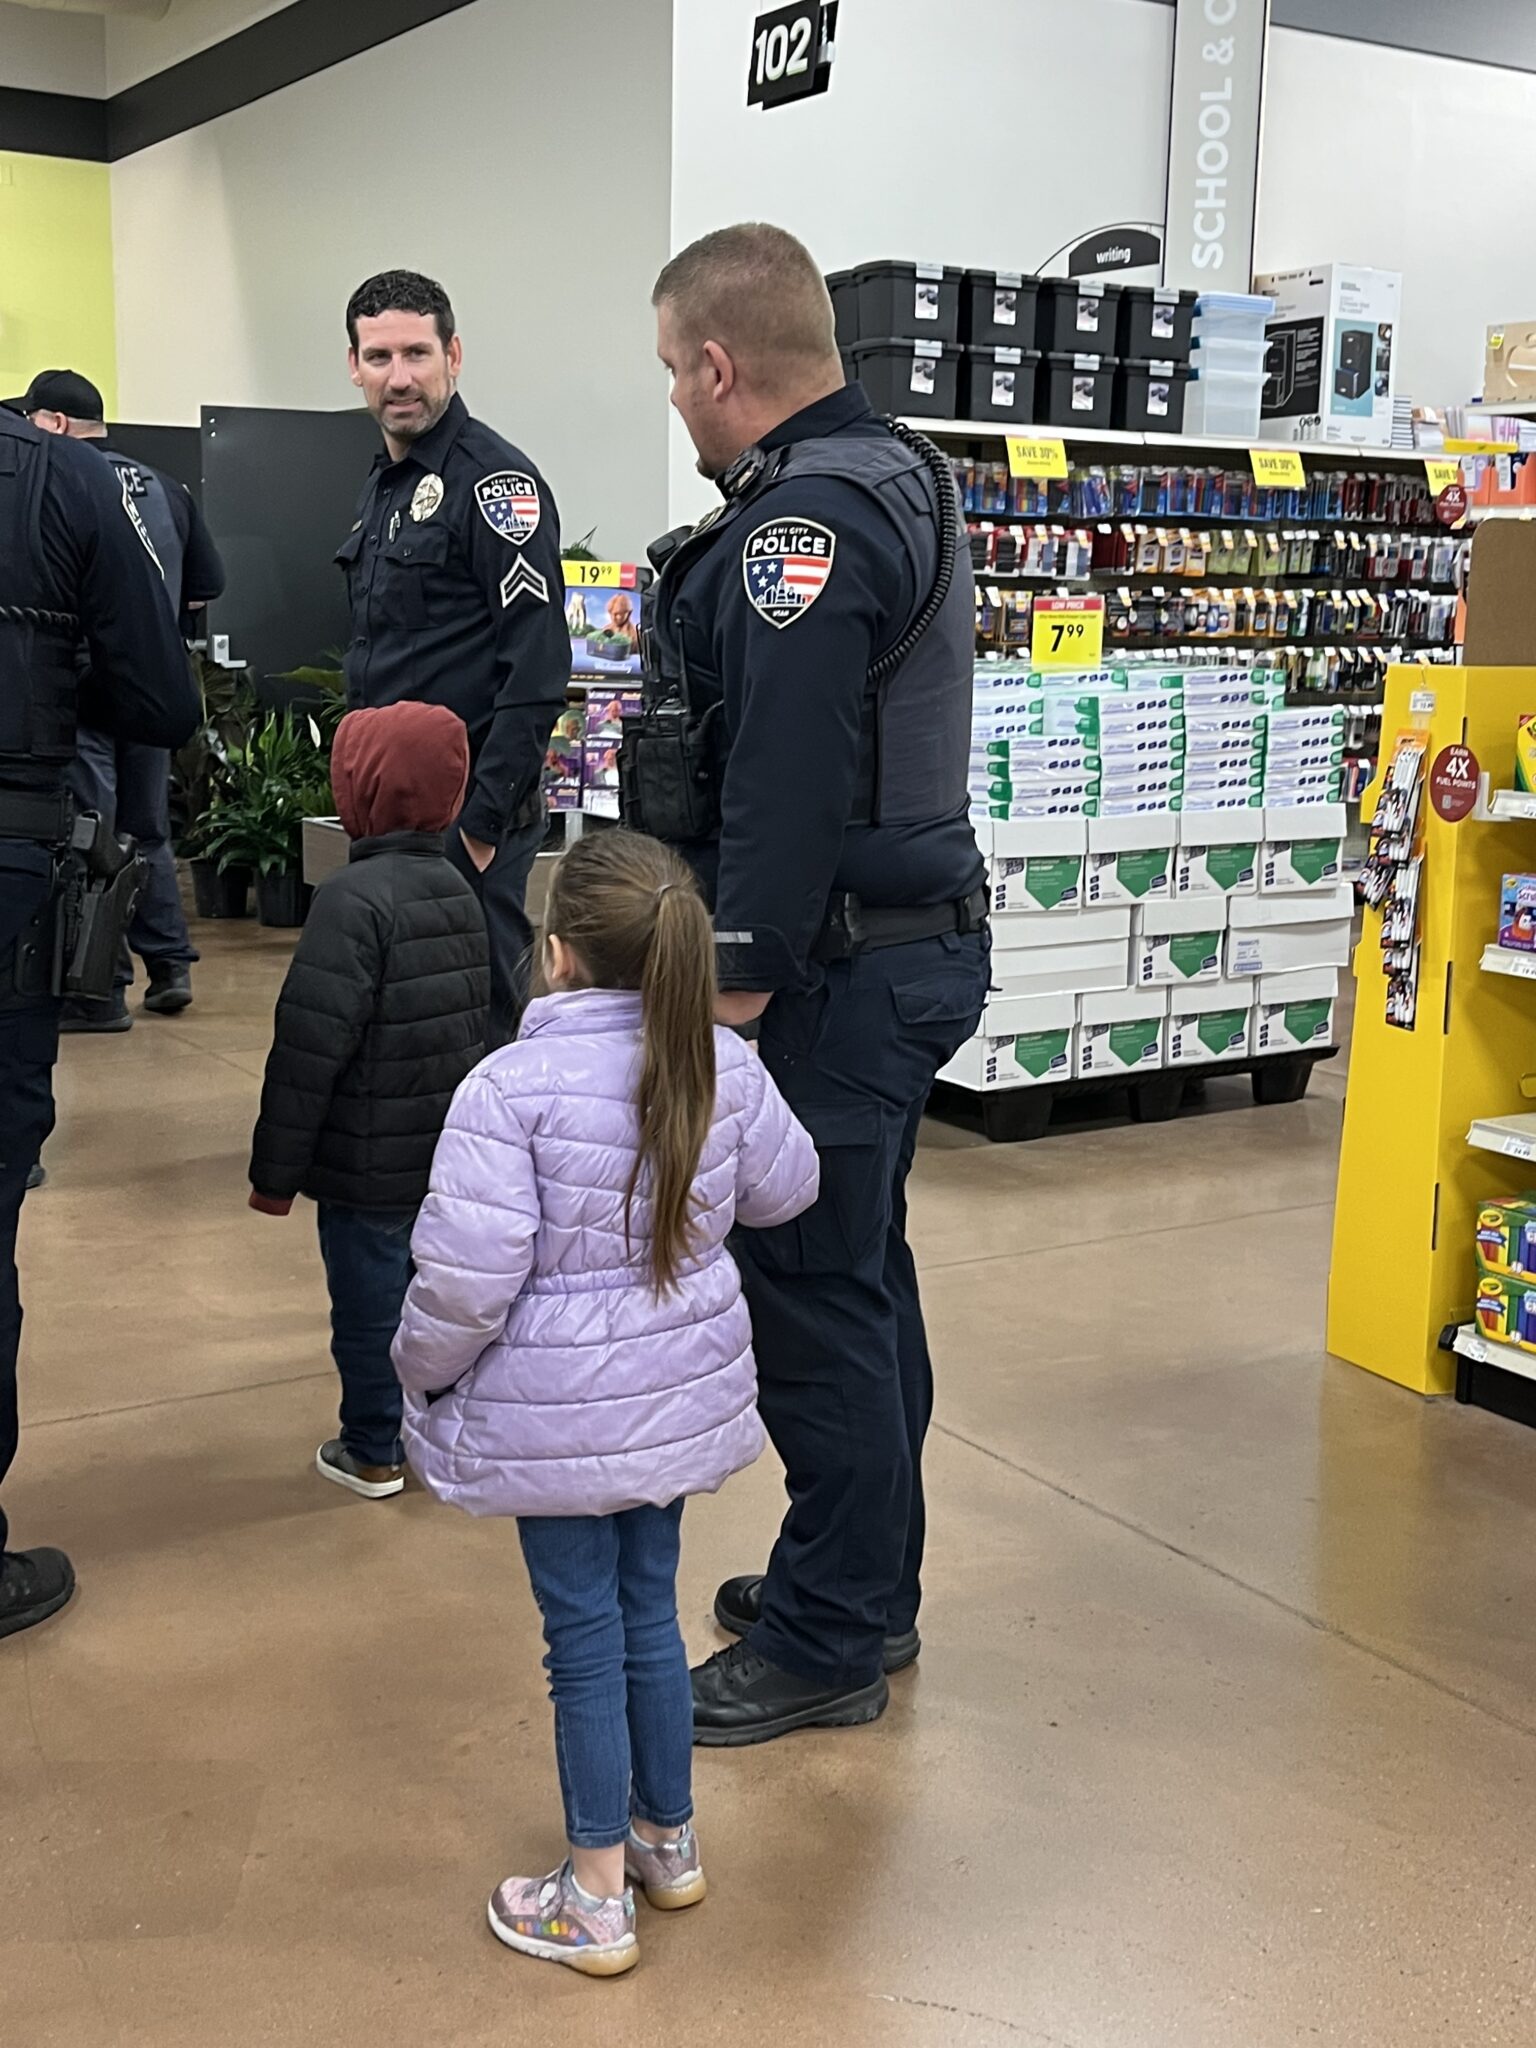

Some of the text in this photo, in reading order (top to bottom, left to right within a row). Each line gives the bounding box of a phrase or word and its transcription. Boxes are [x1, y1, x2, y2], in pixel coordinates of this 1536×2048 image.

[755, 16, 812, 85] 102
[1202, 35, 1235, 65] &
[1191, 76, 1233, 269] SCHOOL
[1096, 245, 1132, 264] writing
[1015, 445, 1039, 459] SAVE
[482, 482, 533, 500] POLICE
[788, 526, 809, 535] CITY
[751, 535, 827, 556] POLICE
[1051, 600, 1085, 610] LOW PRICE
[1445, 756, 1470, 780] 4X
[1435, 776, 1476, 790] FUEL POINTS
